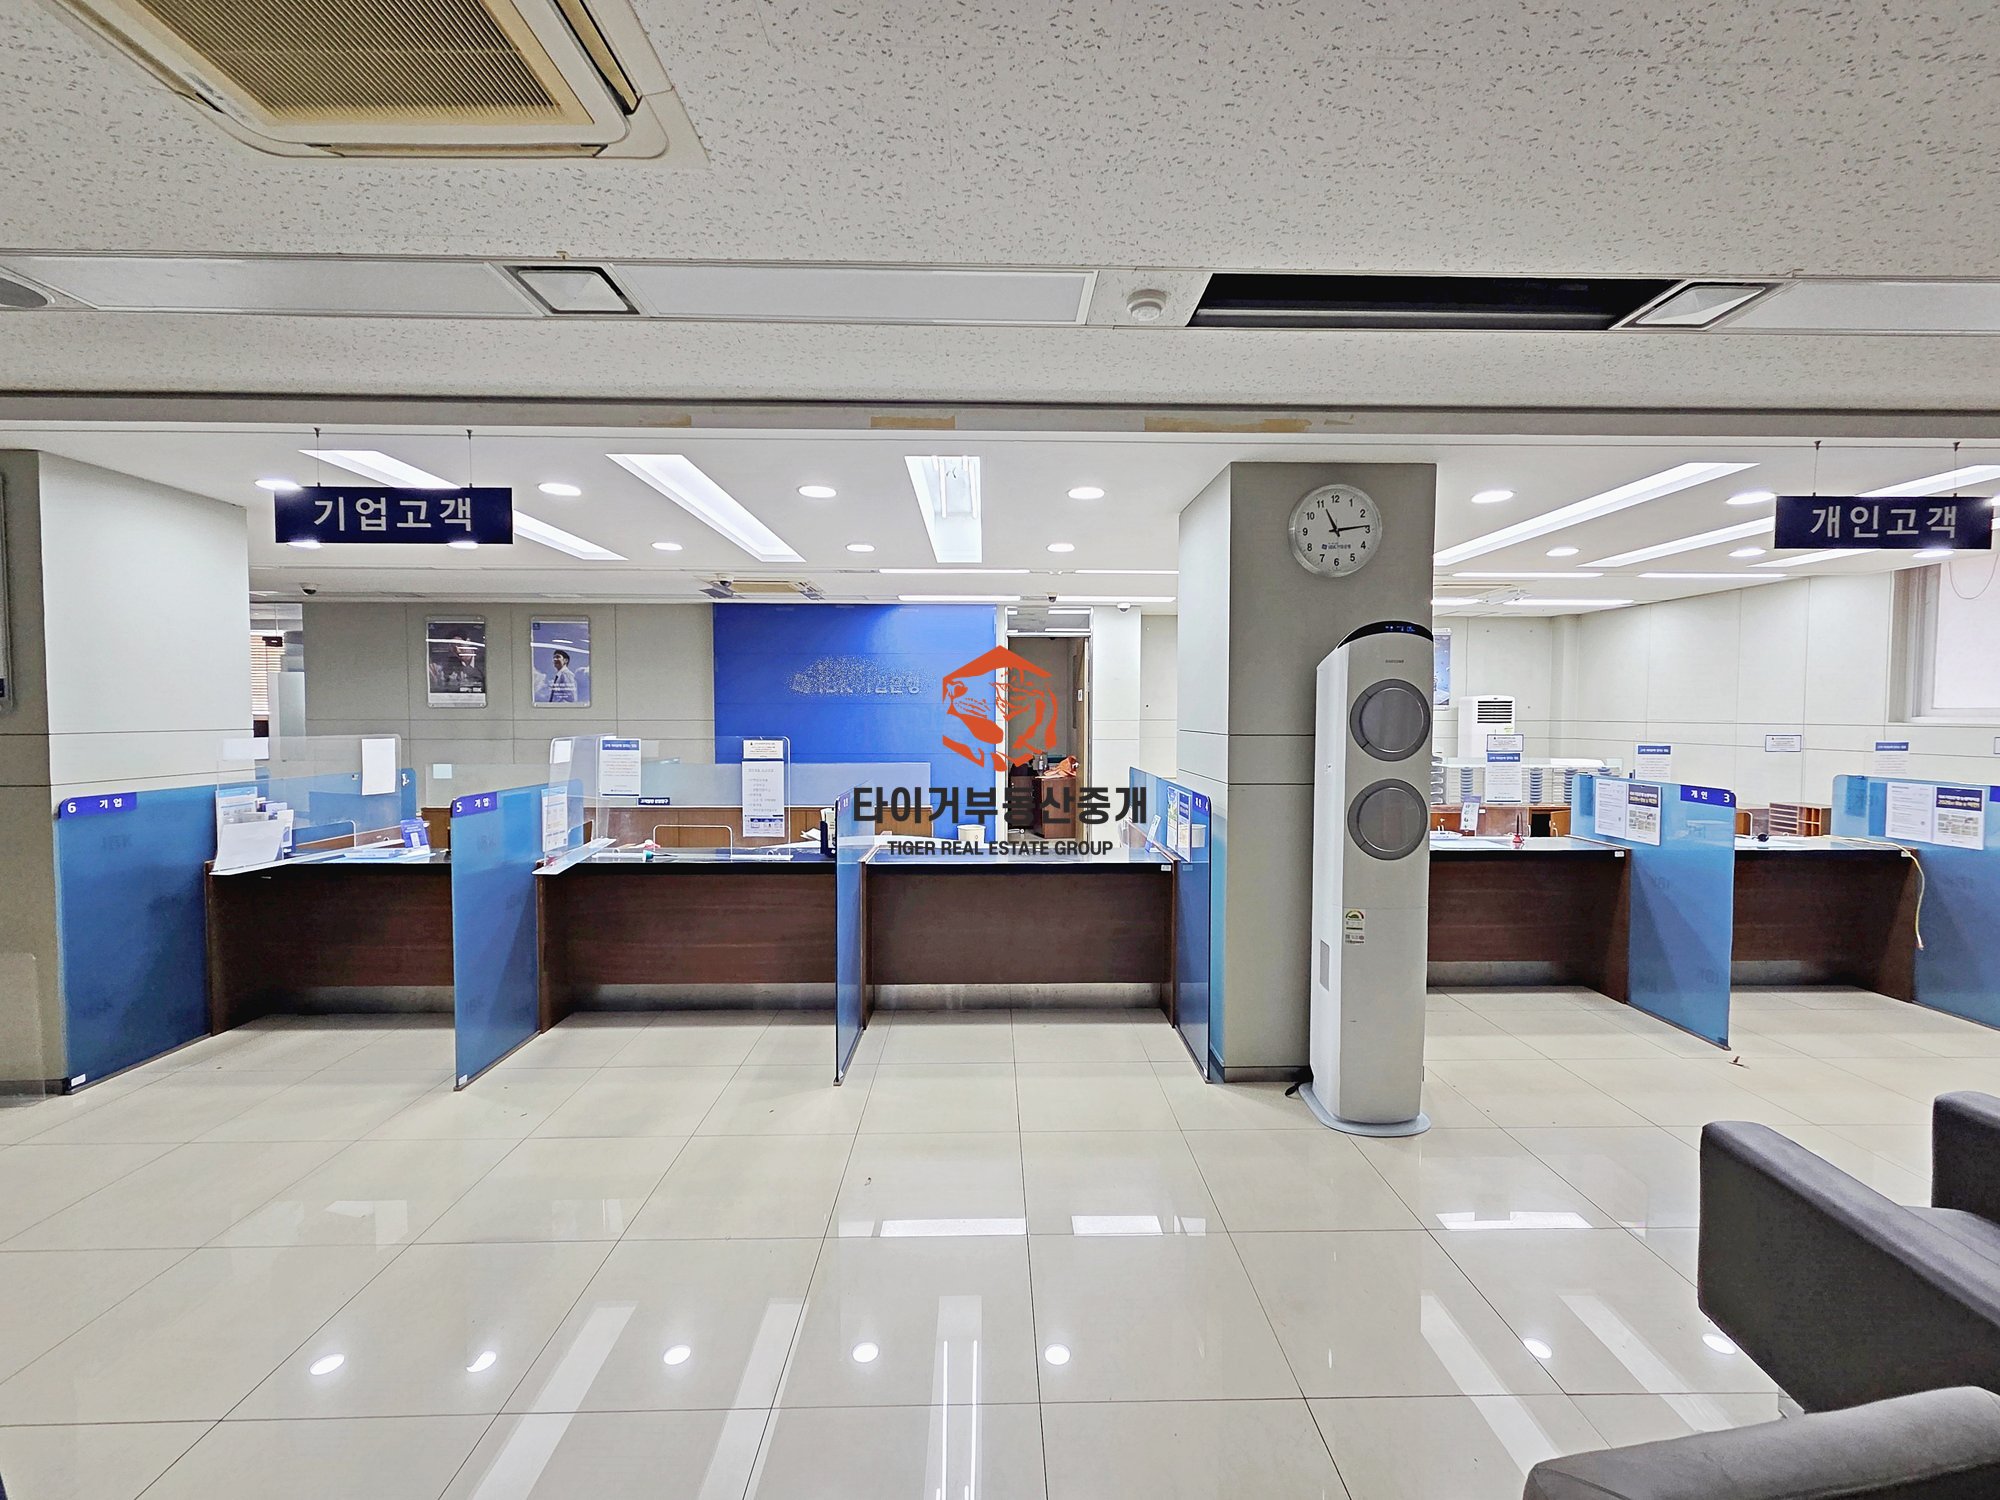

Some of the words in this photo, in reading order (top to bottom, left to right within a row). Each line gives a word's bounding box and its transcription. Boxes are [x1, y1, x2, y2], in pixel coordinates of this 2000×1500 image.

[1331, 494, 1340, 504] 12
[1317, 500, 1325, 508] 11
[313, 495, 474, 532] 기업고객
[1306, 512, 1315, 520] 10
[1360, 509, 1366, 518] 2
[1810, 504, 1958, 539] 개인고객
[1302, 527, 1308, 536] 9
[1365, 525, 1371, 534] 3
[1307, 543, 1312, 551] 8
[1360, 541, 1366, 549] 4
[1319, 554, 1325, 562] 7
[1334, 558, 1340, 566] 6
[1350, 553, 1355, 562] 5
[1723, 793, 1731, 803] 3
[67, 802, 77, 814] 6
[456, 801, 463, 813] 5
